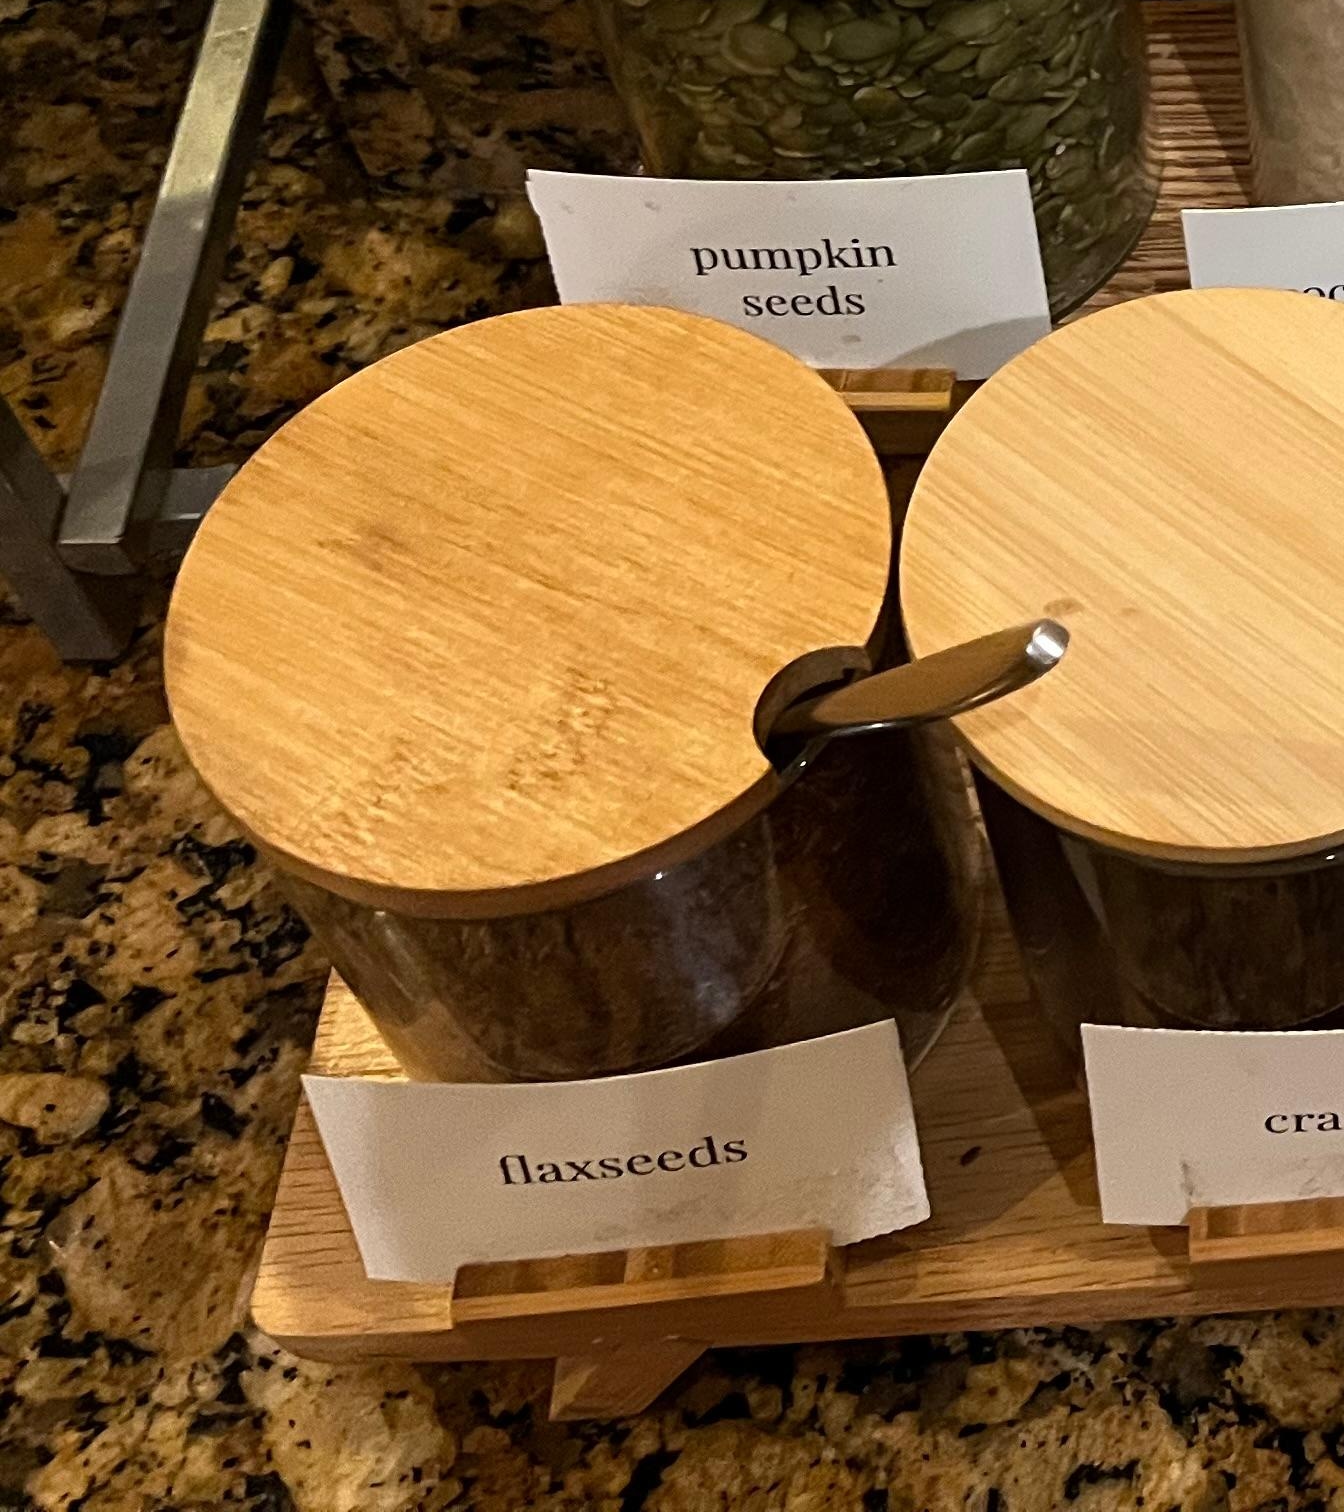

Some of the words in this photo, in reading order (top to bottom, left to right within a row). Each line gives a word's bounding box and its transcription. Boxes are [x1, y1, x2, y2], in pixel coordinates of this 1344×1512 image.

[689, 238, 897, 277] pumpkin
[742, 285, 866, 317] seeds
[499, 1135, 748, 1186] flaxseeds
